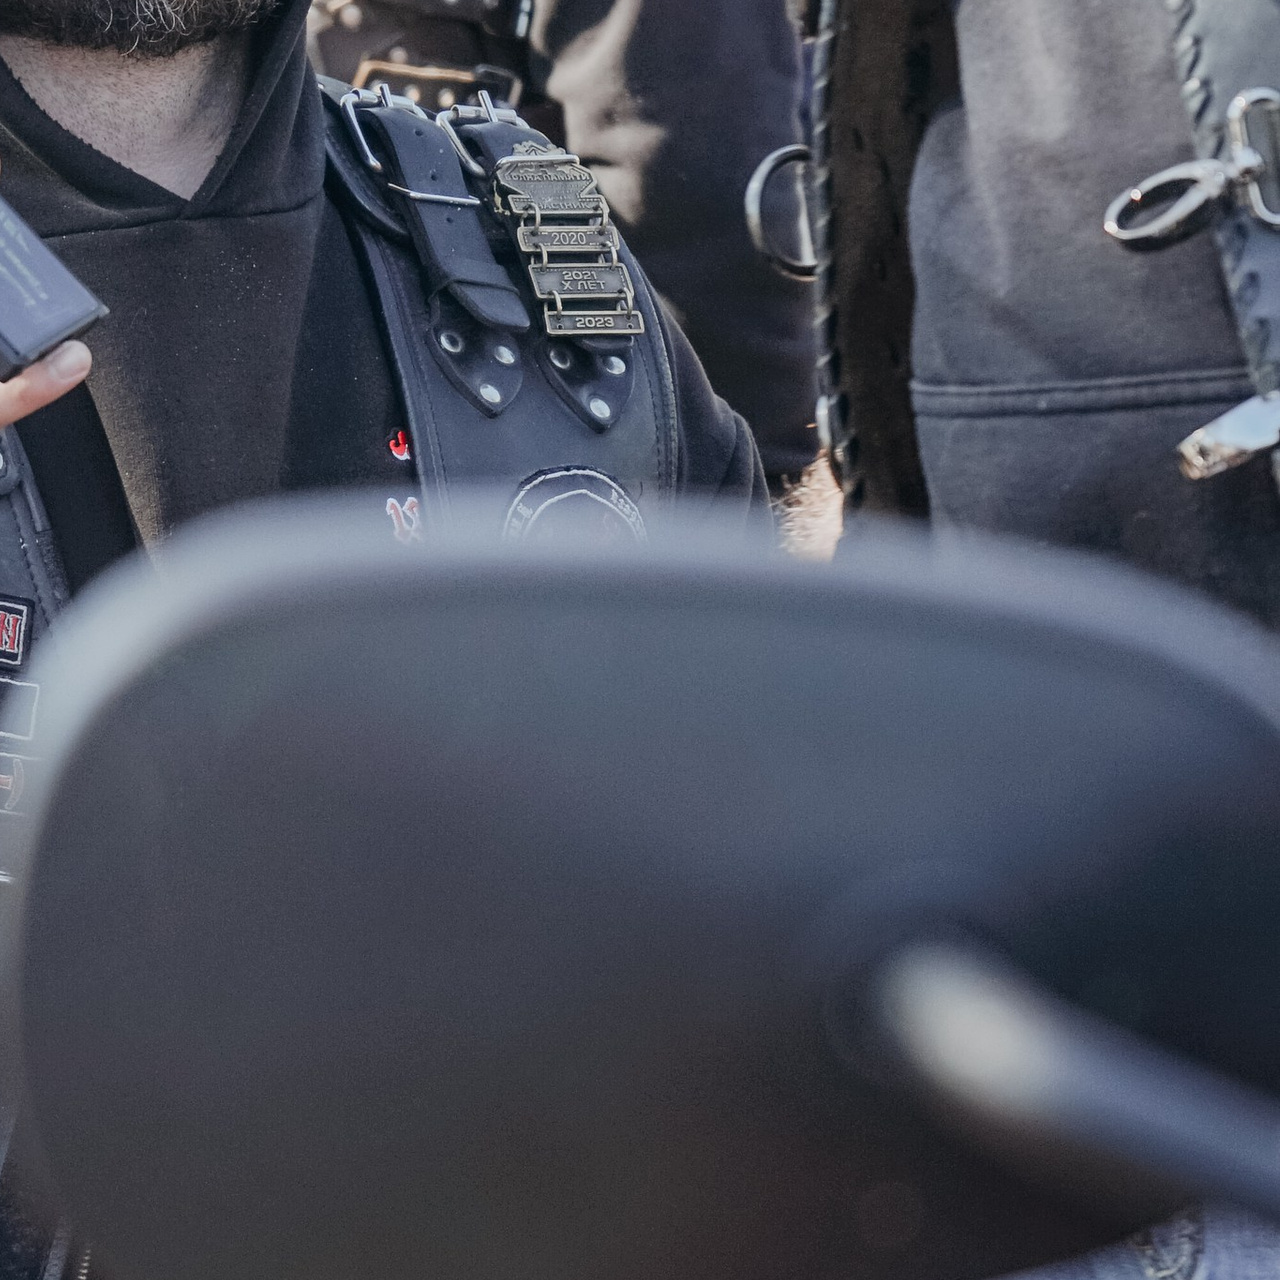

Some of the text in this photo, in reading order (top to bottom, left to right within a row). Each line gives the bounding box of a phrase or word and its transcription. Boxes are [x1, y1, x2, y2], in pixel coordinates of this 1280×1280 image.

[551, 232, 587, 245] 2020
[561, 270, 598, 280] 2021
[577, 280, 606, 290] ЛЕТ
[575, 317, 615, 328] 2023
